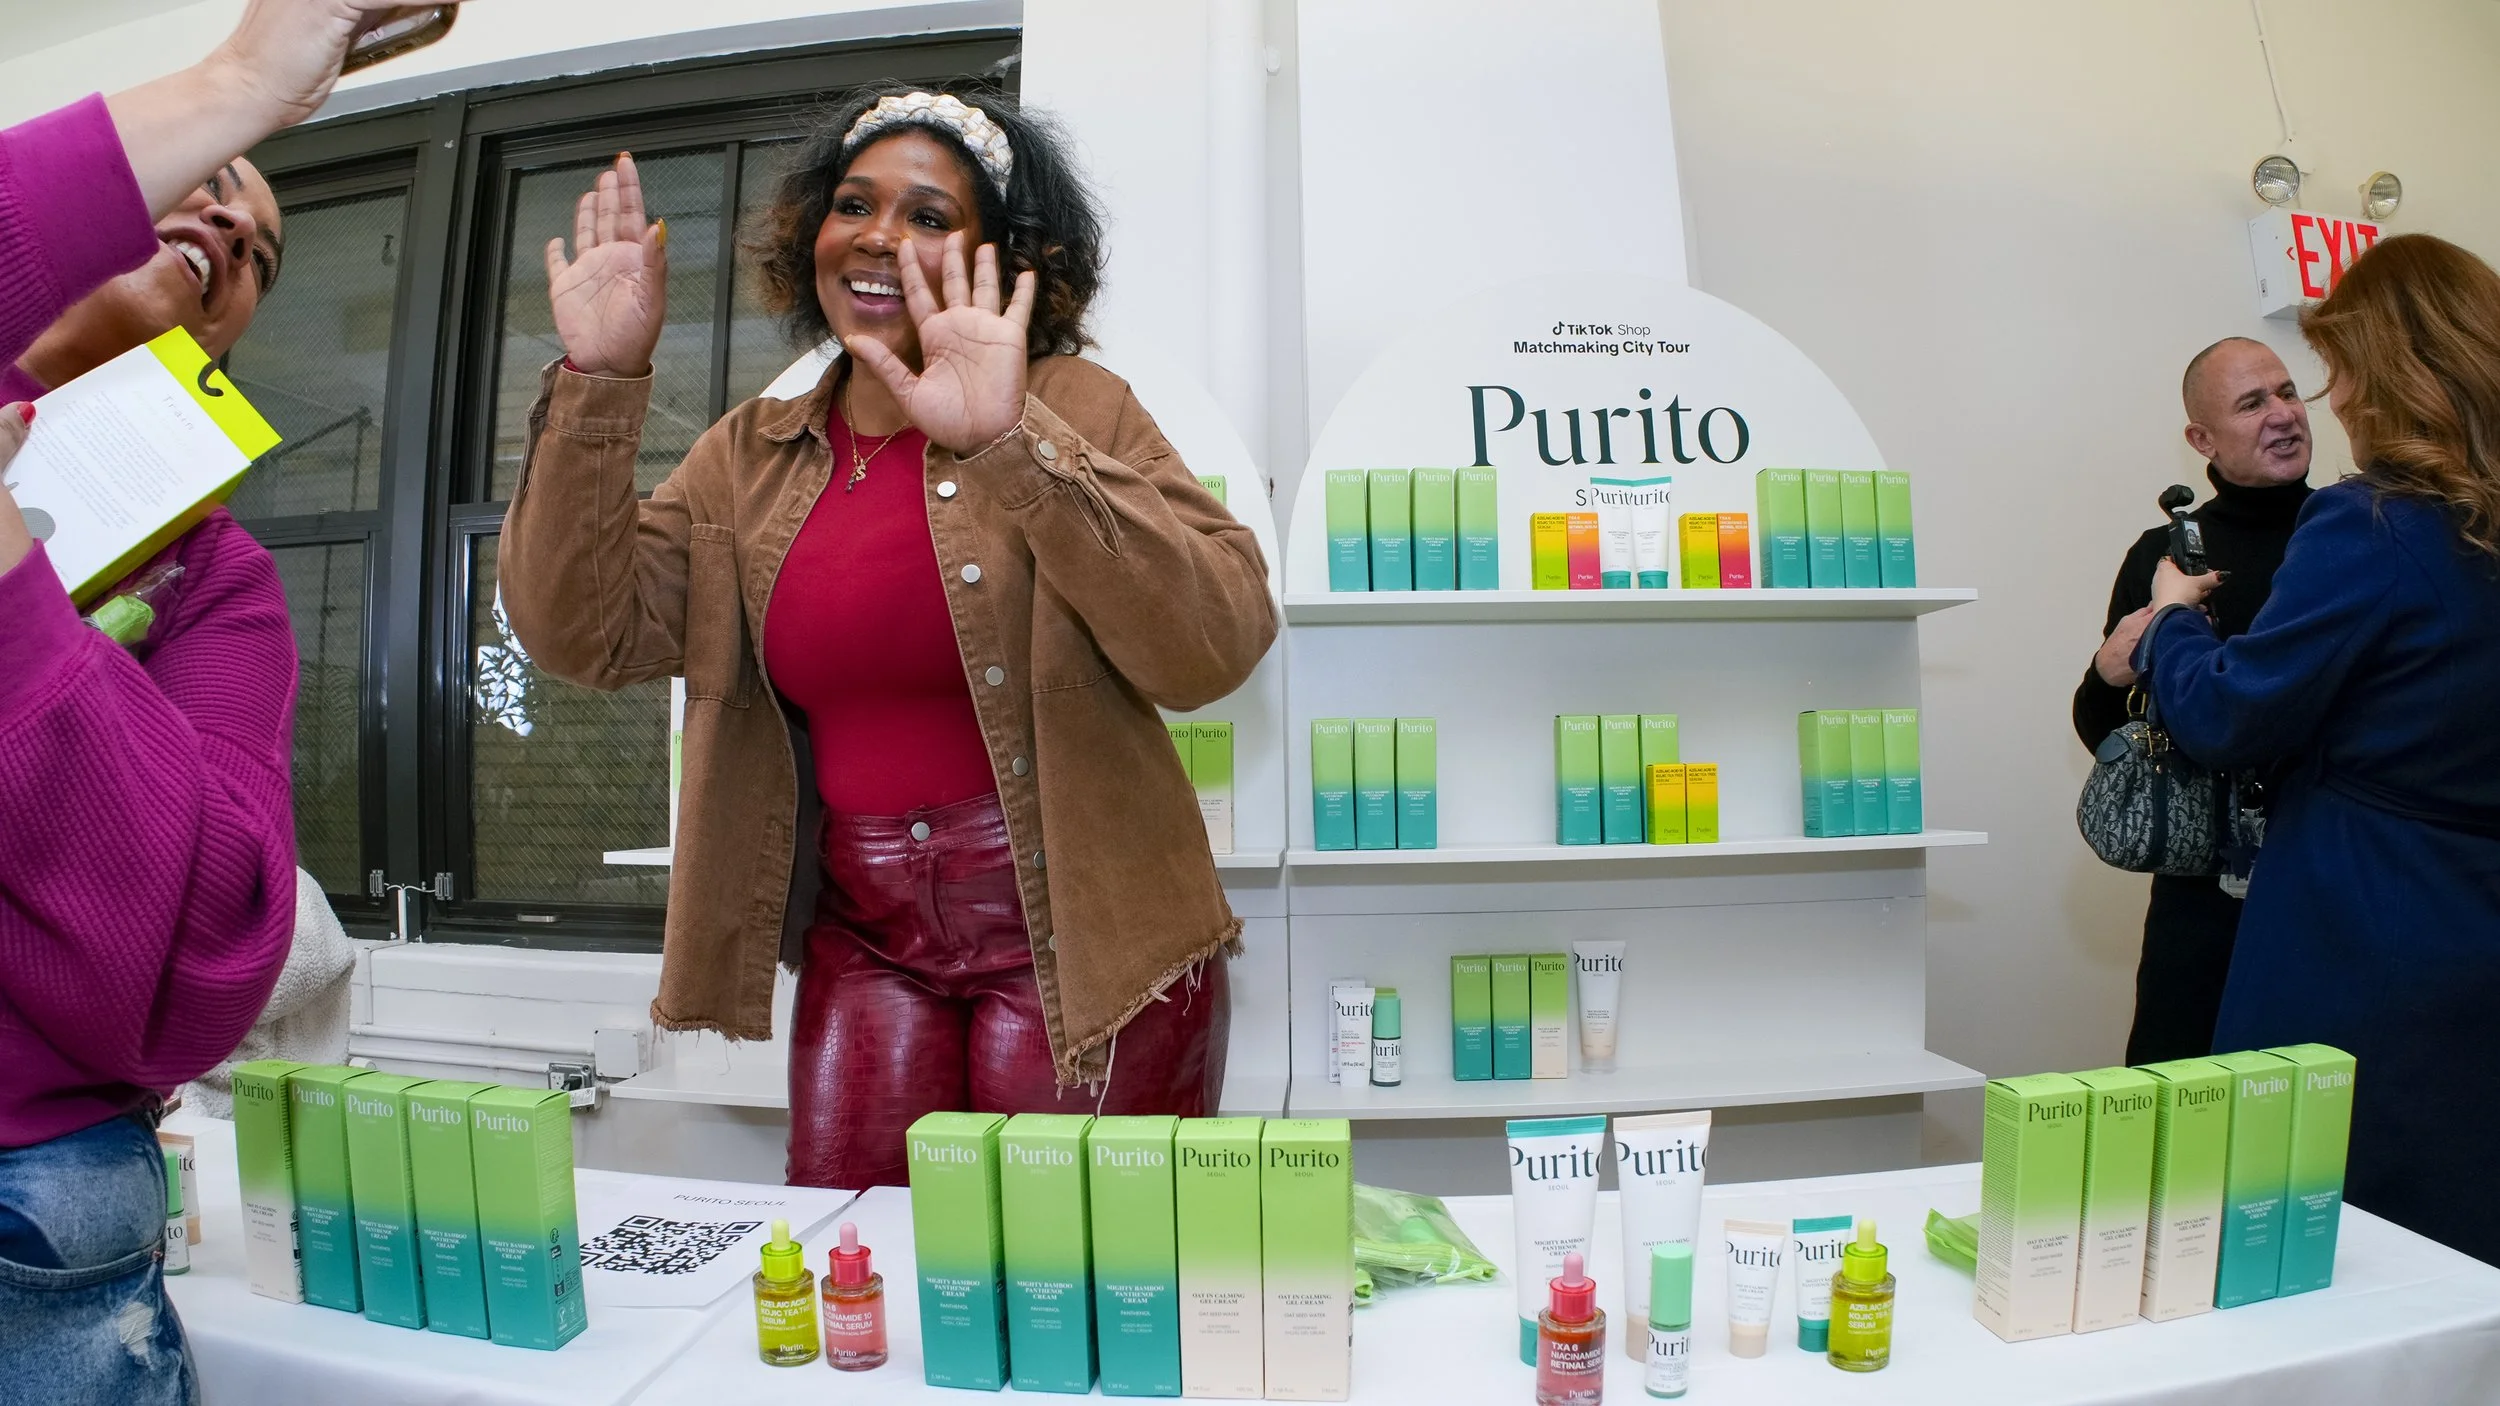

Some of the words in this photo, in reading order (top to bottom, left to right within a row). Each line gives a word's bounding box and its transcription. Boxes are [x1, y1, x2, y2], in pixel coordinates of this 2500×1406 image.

[2290, 213, 2378, 299] EXIT
[1567, 323, 1613, 336] TikTok
[1617, 324, 1651, 336] Shop
[1513, 340, 1619, 357] Matchmaking
[1622, 340, 1654, 356] City
[1657, 341, 1690, 354] Tour
[1465, 385, 1750, 467] Purito
[1329, 472, 1362, 484] Purito
[1373, 472, 1405, 483] Purito
[1418, 471, 1450, 483] Purito
[1462, 471, 1494, 482] Purito
[1770, 471, 1801, 482] Purito
[1809, 472, 1838, 484] Purito
[1842, 472, 1871, 484] Purito
[1879, 473, 1908, 485] Purito
[1820, 715, 1848, 725] Purito
[1851, 714, 1879, 725] Purito
[1885, 713, 1916, 724] Purito
[1315, 724, 1348, 735] Purito
[1358, 723, 1390, 734] Purito
[1400, 722, 1433, 733] Purito
[1564, 719, 1596, 732] Purito
[1604, 719, 1636, 731] Purito
[1645, 719, 1676, 730] Purito
[1169, 728, 1189, 739] rito
[1195, 727, 1227, 739] Purito
[1456, 963, 1487, 974] Purito
[1495, 962, 1526, 973] Purito
[1534, 961, 1565, 972] Purito
[2306, 1070, 2353, 1092] Purito
[234, 1077, 274, 1101] Purito
[2242, 1076, 2289, 1099] Purito
[291, 1083, 335, 1107] Purito
[2177, 1085, 2226, 1107] Purito
[348, 1094, 394, 1118] Purito
[2103, 1093, 2153, 1115] Purito
[411, 1101, 462, 1125] Purito
[2029, 1101, 2083, 1122] Purito
[475, 1109, 529, 1133] Purito
[913, 1140, 977, 1164] Purito
[1007, 1143, 1073, 1167] Purito
[1096, 1145, 1165, 1168] Purito
[1182, 1147, 1251, 1169] Purito
[1270, 1147, 1340, 1169] Purito
[1655, 1179, 1676, 1187] SEOUL
[673, 1194, 732, 1205] PURITO
[1560, 1237, 1585, 1245] BAMBOO
[926, 1276, 951, 1285] MIGHTY
[952, 1279, 981, 1287] BAMBOO
[1016, 1280, 1043, 1288] MIGHTY
[1043, 1282, 1073, 1290] BAMBOO
[934, 1284, 972, 1292] PANTHENOL
[1025, 1287, 1065, 1295] PANTHENOL
[1106, 1284, 1133, 1292] MIGHTY
[941, 1290, 966, 1298] CREAM
[1032, 1293, 1058, 1301] CREAM
[784, 1308, 799, 1317] TEA
[863, 1311, 872, 1321] 10
[1848, 1312, 1874, 1320] KOJIC
[846, 1320, 873, 1330] SERUM
[1848, 1320, 1877, 1329] SERUM
[780, 1344, 804, 1352] Purito
[833, 1347, 857, 1357] Purito
[1551, 1341, 1571, 1352] TXA
[1571, 1343, 1579, 1352] 6
[1551, 1359, 1587, 1370] RETINAL
